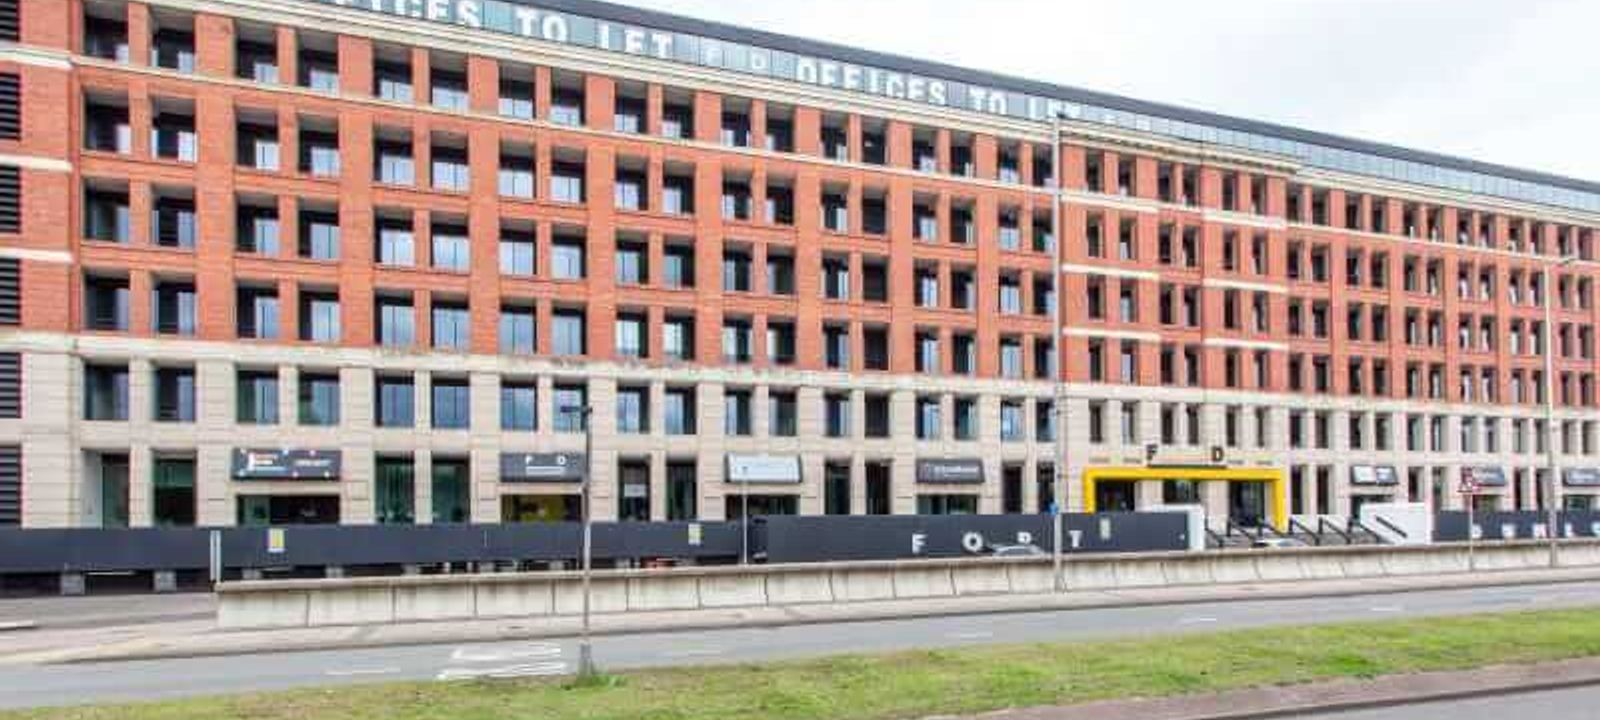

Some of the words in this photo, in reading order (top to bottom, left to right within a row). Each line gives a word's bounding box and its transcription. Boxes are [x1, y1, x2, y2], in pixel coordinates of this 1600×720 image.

[515, 5, 568, 42] TO
[796, 56, 946, 105] OFFICES
[968, 87, 1008, 115] TO
